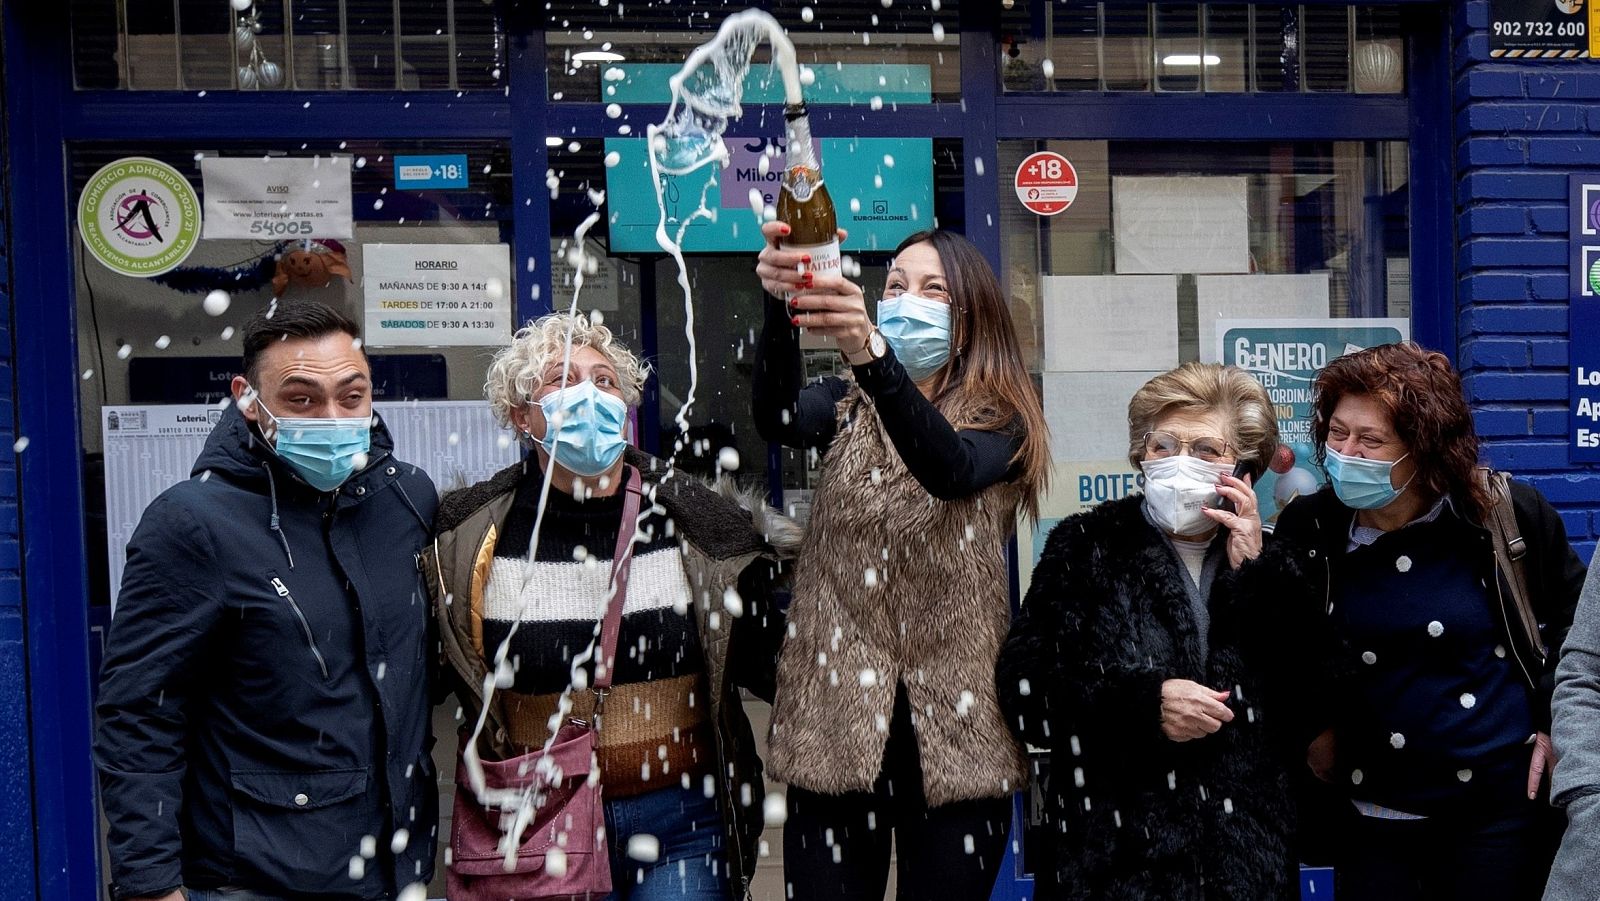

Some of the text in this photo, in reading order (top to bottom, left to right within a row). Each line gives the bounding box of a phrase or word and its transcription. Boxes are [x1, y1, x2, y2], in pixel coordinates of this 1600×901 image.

[1493, 21, 1585, 36] 902 732 600
[434, 164, 458, 179] +18
[1028, 160, 1062, 179] +18
[266, 185, 289, 193] AVISO
[87, 165, 194, 231] COMERCIO ADHERIDO 2020/21
[233, 211, 324, 219] www.loteriasyaestas.es
[250, 220, 313, 235] 54005
[87, 221, 187, 268] REACTIVEMOS ALCANTARILLA
[415, 261, 458, 270] HORARIO
[379, 281, 424, 290] MAÑANAS
[382, 301, 418, 309] TARDES
[381, 320, 425, 329] SÁBADOS
[1255, 342, 1326, 370] ENERO
[1252, 373, 1278, 387] TEO
[176, 413, 207, 422] Lotería
[1278, 421, 1311, 432] LLONES
[1577, 429, 1600, 447] Es
